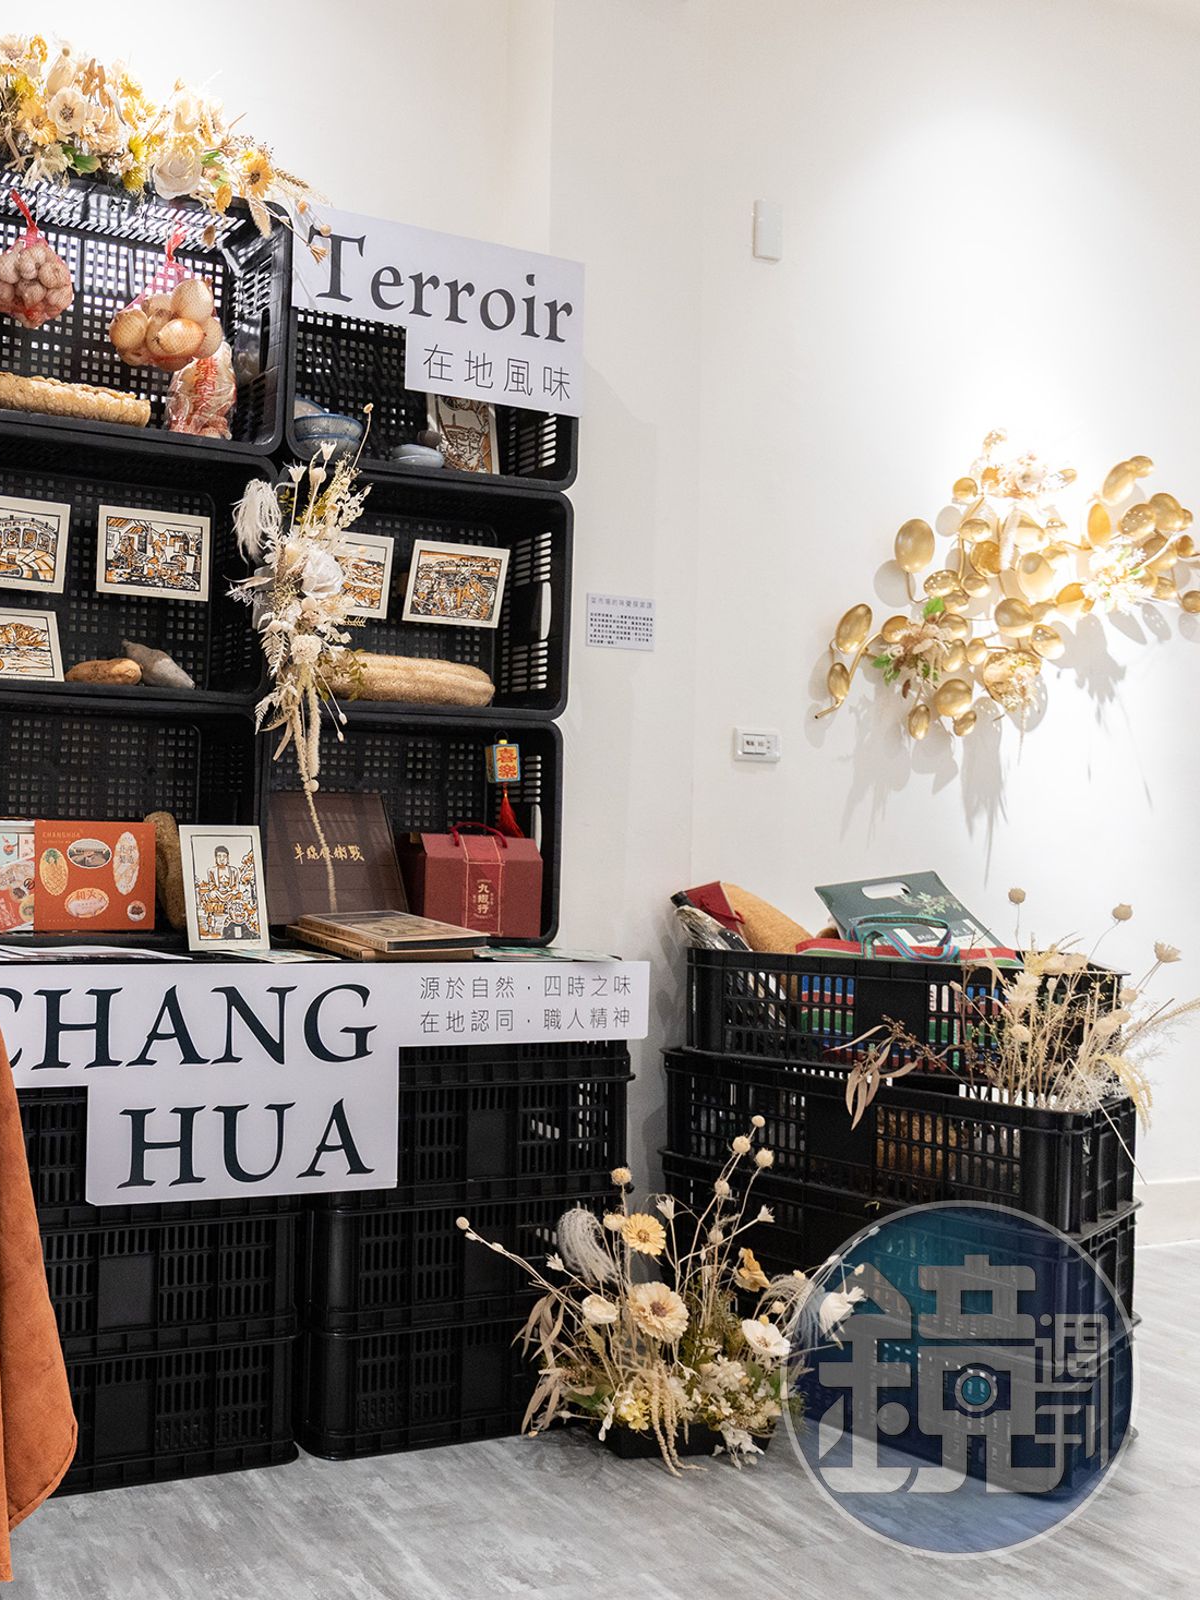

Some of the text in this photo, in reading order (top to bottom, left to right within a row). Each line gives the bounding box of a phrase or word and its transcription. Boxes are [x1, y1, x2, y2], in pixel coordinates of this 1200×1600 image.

[308, 224, 573, 343] Terroir
[423, 343, 571, 401] 在地風味
[117, 1097, 375, 1189] HUA
